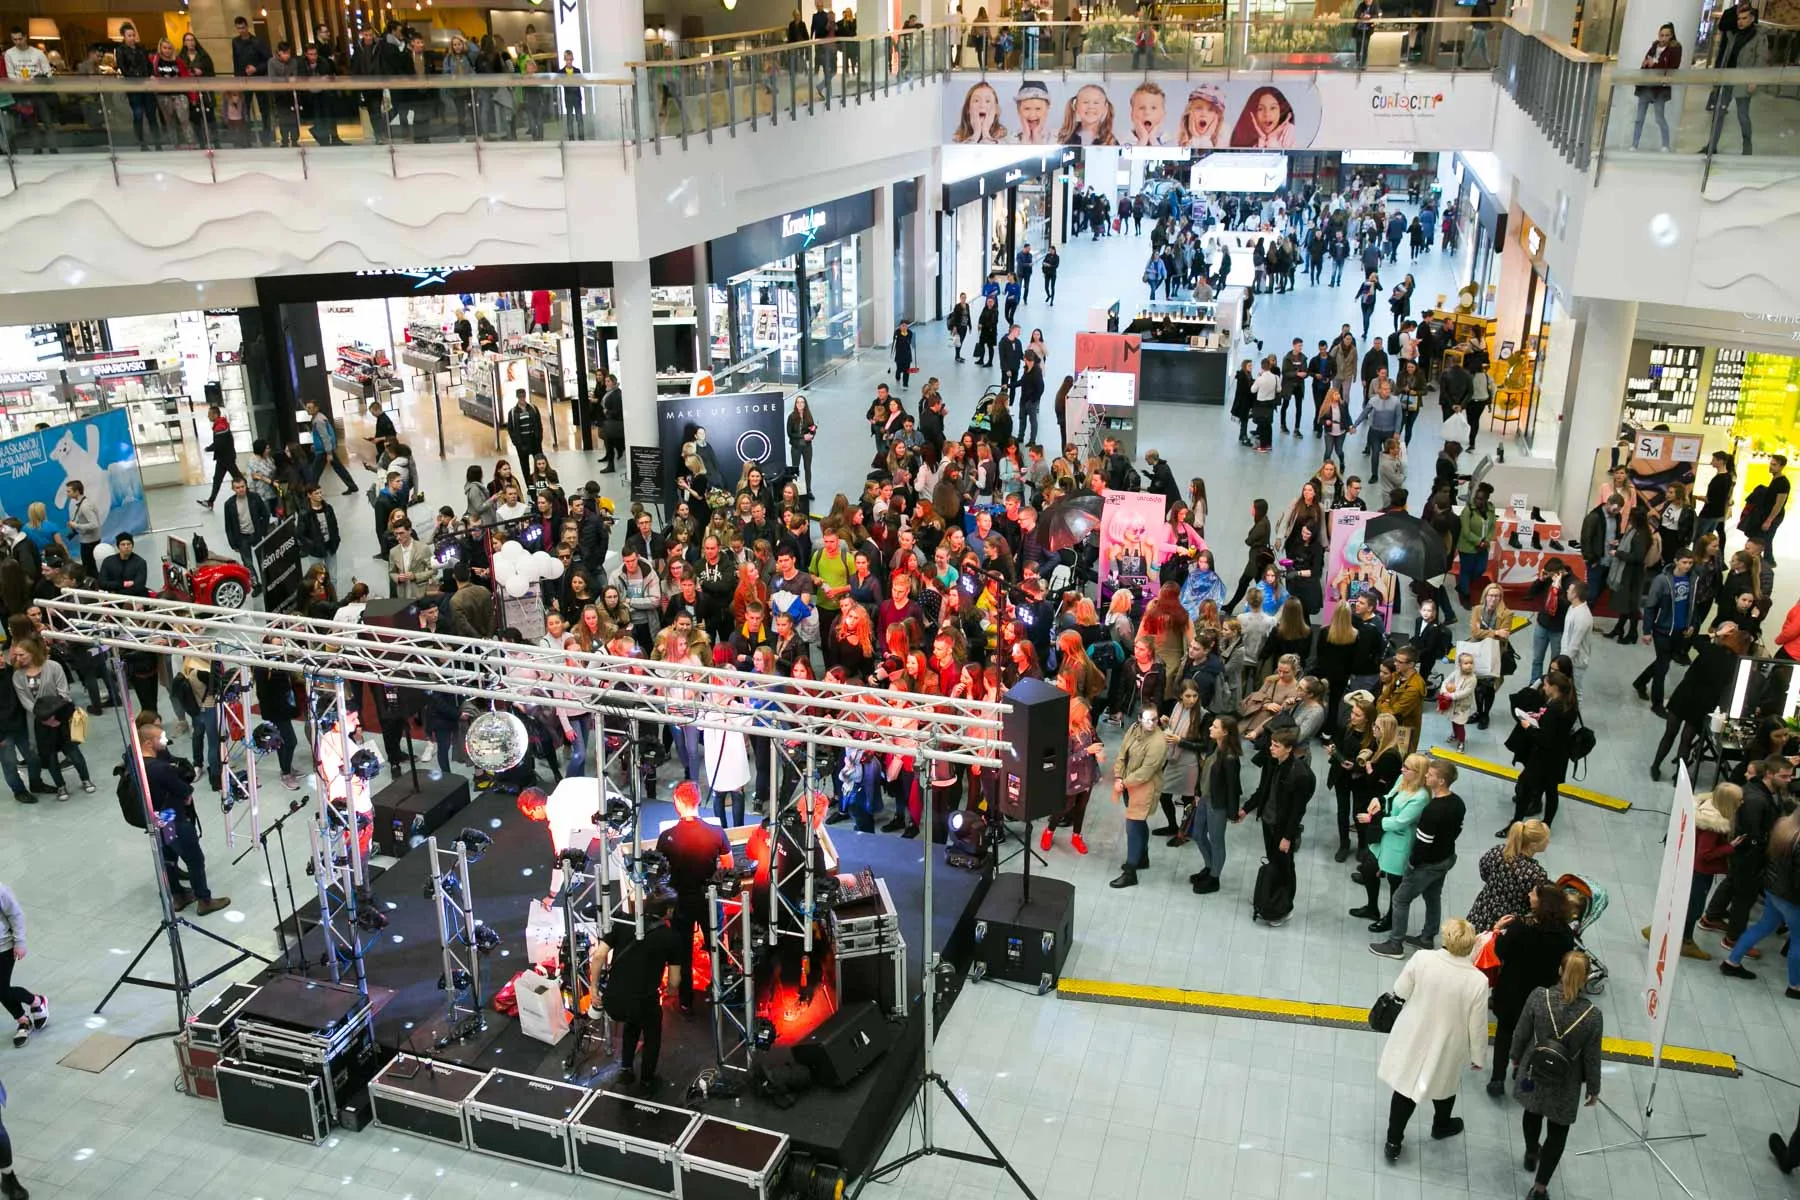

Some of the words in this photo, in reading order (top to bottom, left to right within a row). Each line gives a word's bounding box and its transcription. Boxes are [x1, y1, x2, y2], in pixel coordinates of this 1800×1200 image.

[93, 361, 147, 376] SWAROVSKI
[666, 409, 704, 420] MAKE
[736, 403, 777, 415] STORE
